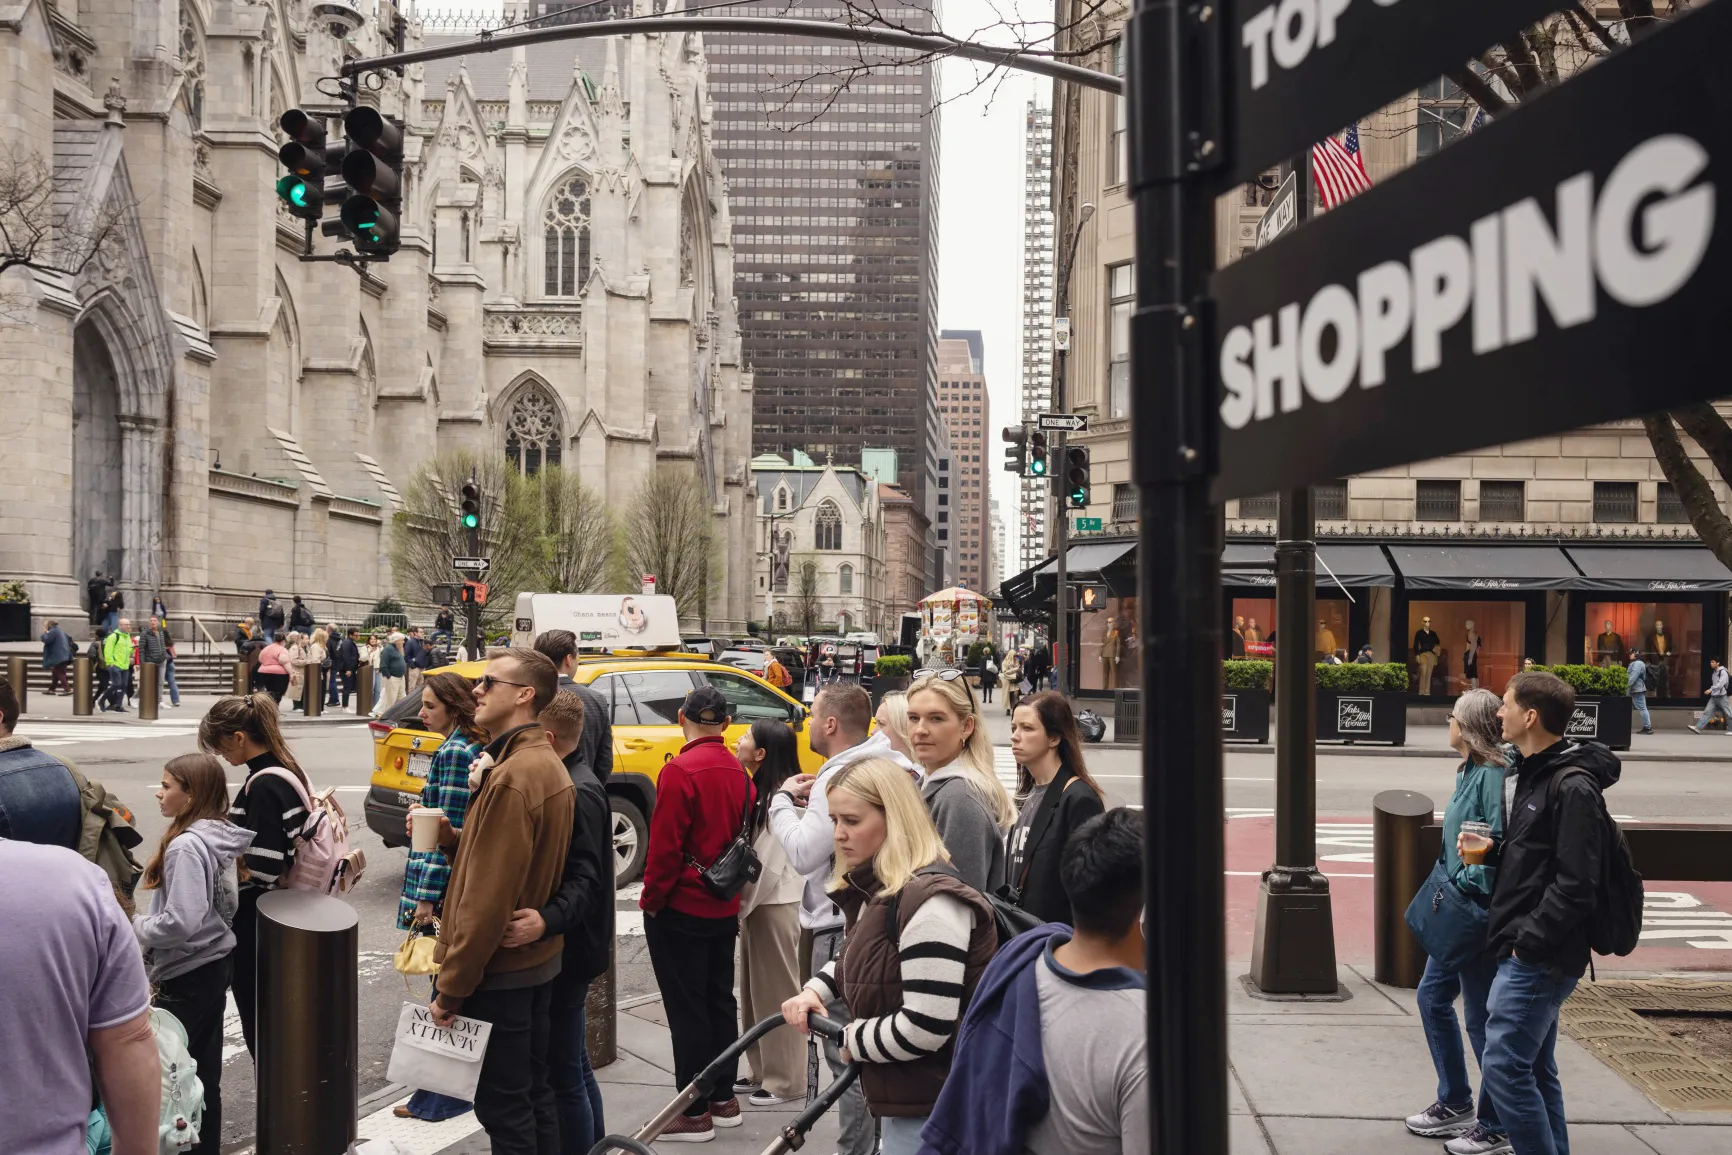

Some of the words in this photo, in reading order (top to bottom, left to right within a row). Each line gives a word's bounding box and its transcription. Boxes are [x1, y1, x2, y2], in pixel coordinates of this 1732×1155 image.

[1242, 0, 1351, 91] TOP
[1276, 194, 1293, 231] WAY
[1220, 134, 1717, 431] SHOPPING
[1081, 519, 1087, 529] 5
[1468, 579, 1485, 588] Saks
[1497, 579, 1520, 589] Avenue
[1648, 581, 1665, 590] Saks
[1677, 581, 1700, 590] Avenue
[1340, 703, 1360, 716] Saks
[1340, 716, 1368, 727] Avenue
[412, 1008, 482, 1036] JACON
[406, 1022, 477, 1052] McNALLY
